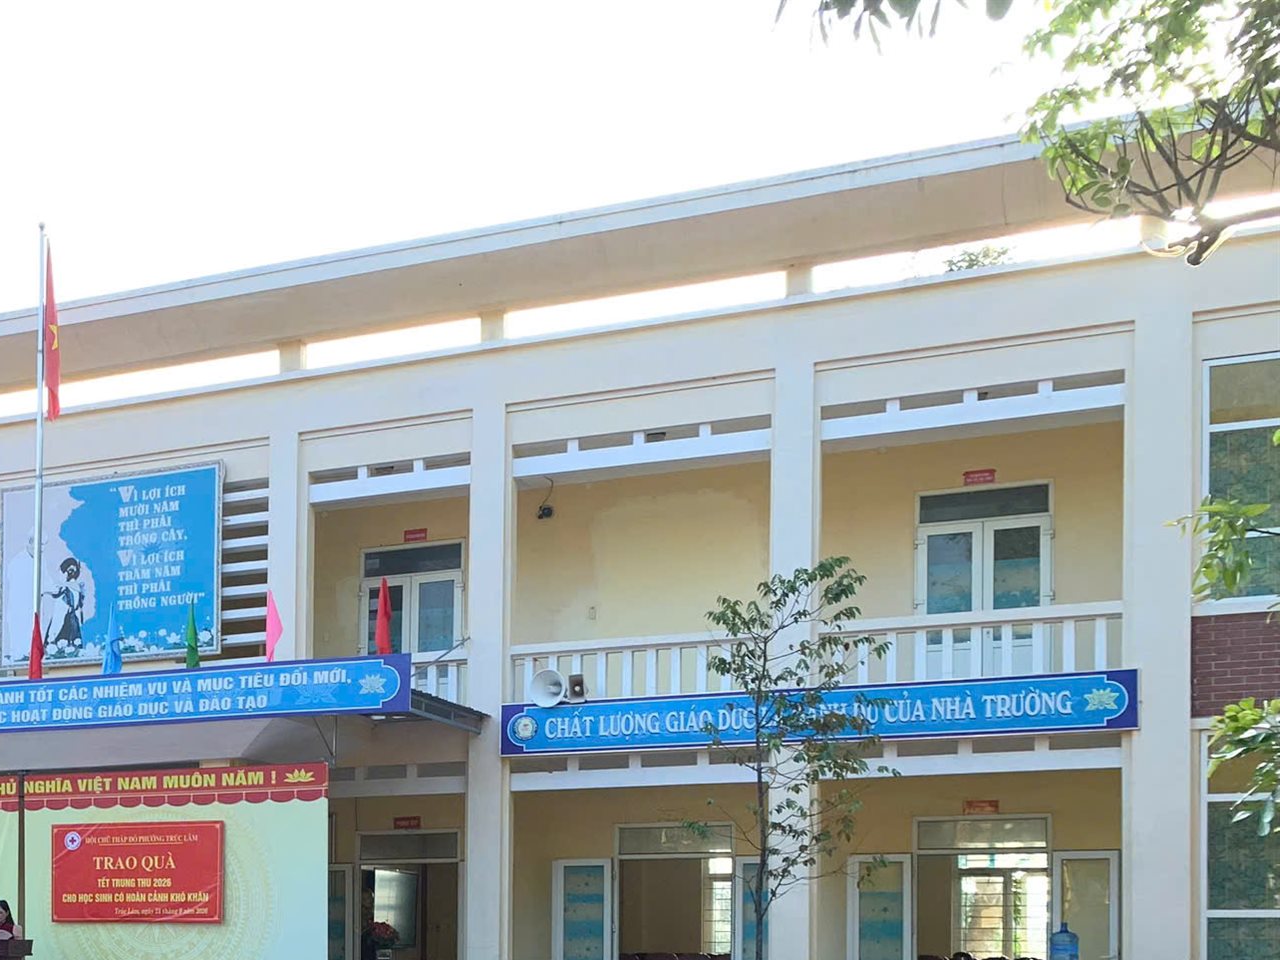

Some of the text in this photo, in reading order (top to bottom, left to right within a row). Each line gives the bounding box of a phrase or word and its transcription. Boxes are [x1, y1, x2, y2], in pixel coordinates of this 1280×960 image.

[28, 685, 54, 703] TỐT
[147, 681, 168, 698] VỤ
[171, 677, 192, 693] VÀ
[238, 672, 275, 689] TIÊU
[544, 708, 594, 738] CHẤT
[599, 709, 660, 740] LƯỢNG
[718, 707, 756, 736] DỤC
[884, 691, 926, 723] CỦA
[931, 690, 976, 721] NHÀ
[981, 687, 1073, 719] TRƯỜNG
[23, 776, 73, 795] NGHĨA
[77, 775, 113, 794] VIỆT
[117, 776, 158, 791] NAM
[162, 772, 217, 789] MUÔN
[221, 770, 265, 787] NĂM
[93, 852, 176, 872] TRAO QUÀ
